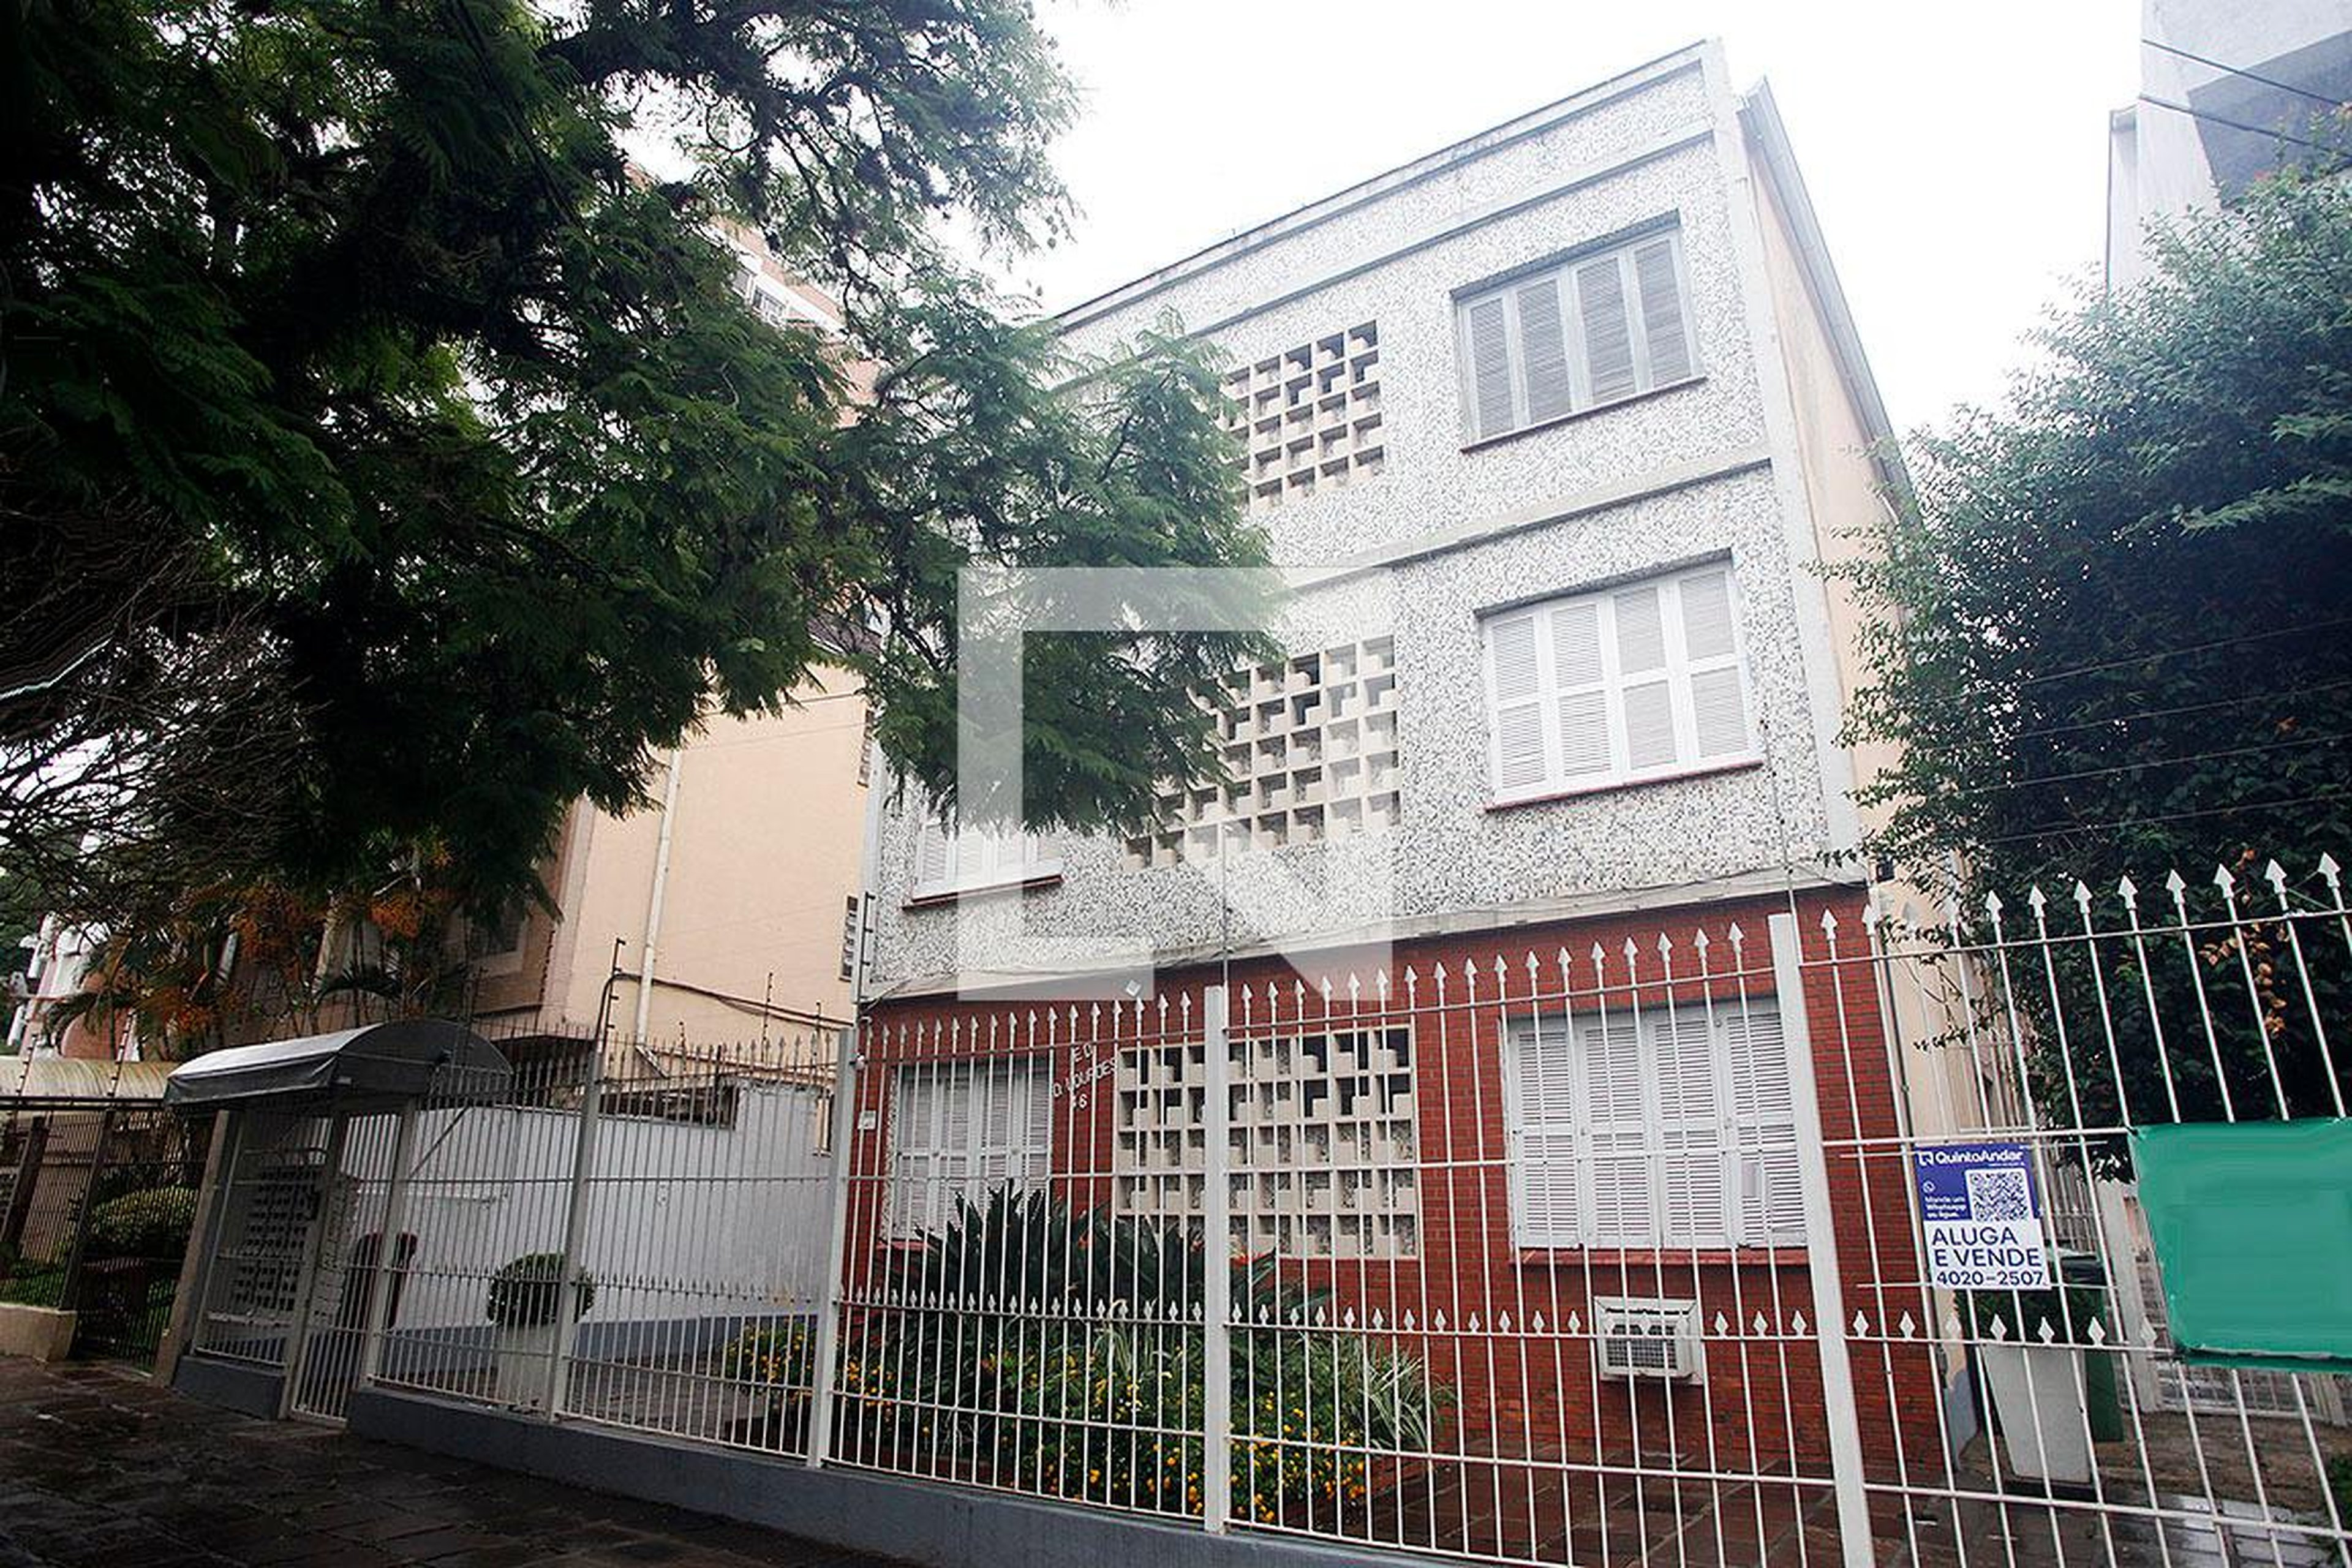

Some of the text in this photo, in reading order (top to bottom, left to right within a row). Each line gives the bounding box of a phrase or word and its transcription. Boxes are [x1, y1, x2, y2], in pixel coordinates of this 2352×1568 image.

[1936, 1150, 2023, 1164] QuintoAndar
[1932, 1227, 2018, 1245] ALUGA
[1934, 1248, 2041, 1267] E VENDE
[1937, 1271, 2043, 1286] 4020-2507
